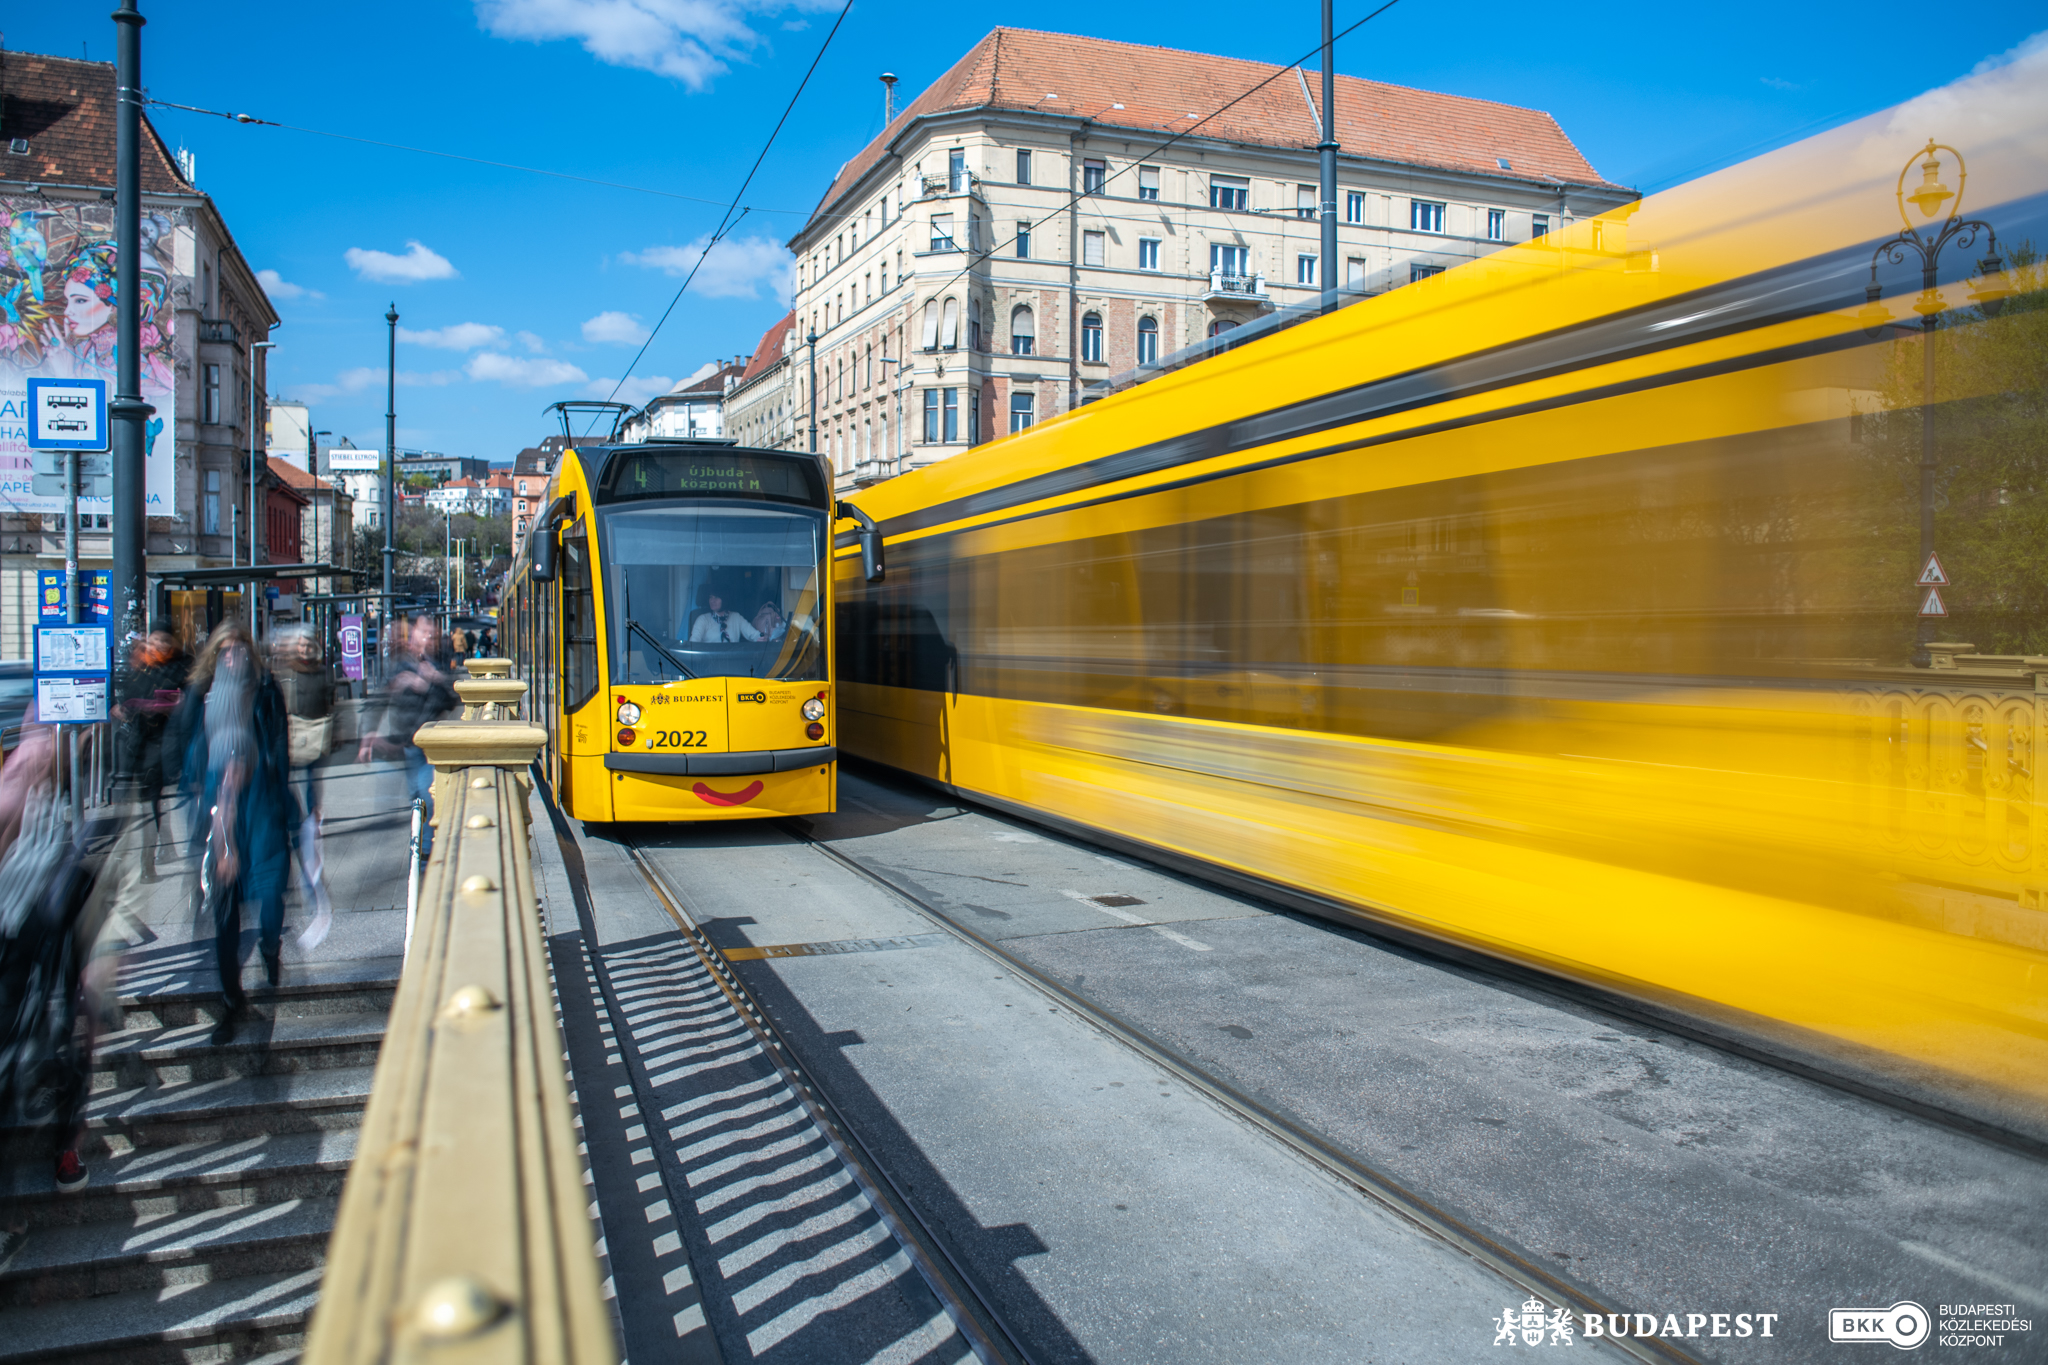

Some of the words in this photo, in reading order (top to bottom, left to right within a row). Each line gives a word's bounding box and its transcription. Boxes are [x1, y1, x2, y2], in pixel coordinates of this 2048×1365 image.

[331, 453, 354, 461] STIEBEL
[635, 463, 648, 488] 4
[680, 478, 744, 490] központ
[749, 479, 760, 490] M
[673, 695, 724, 703] BUDAPEST
[655, 730, 708, 748] 2022
